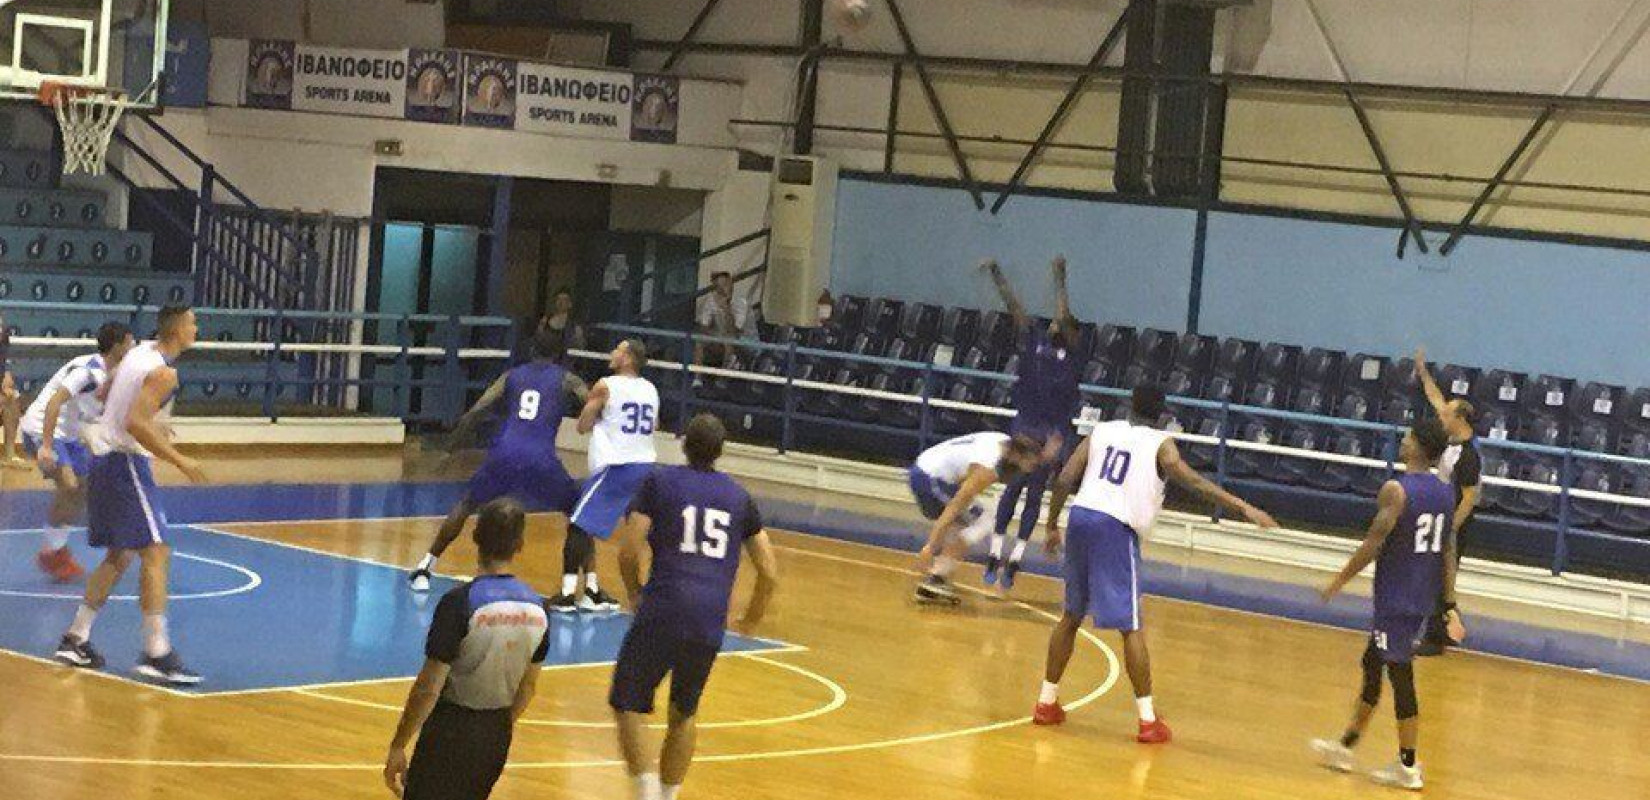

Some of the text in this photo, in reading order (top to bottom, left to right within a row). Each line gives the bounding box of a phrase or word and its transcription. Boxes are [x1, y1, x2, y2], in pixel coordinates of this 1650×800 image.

[296, 53, 405, 80] ΙΒΑΝΩΦΕΙΟ
[304, 85, 350, 102] SPORTS
[353, 89, 391, 104] ARENA
[519, 73, 631, 104] ΙΒΑΝΩΦΕΙΟ
[528, 106, 575, 124] SPORTS
[578, 112, 618, 127] ARENA
[518, 389, 541, 421] 9
[621, 401, 654, 435] 35
[1098, 445, 1132, 486] 10
[679, 504, 731, 559] 15
[1414, 512, 1445, 554] 21
